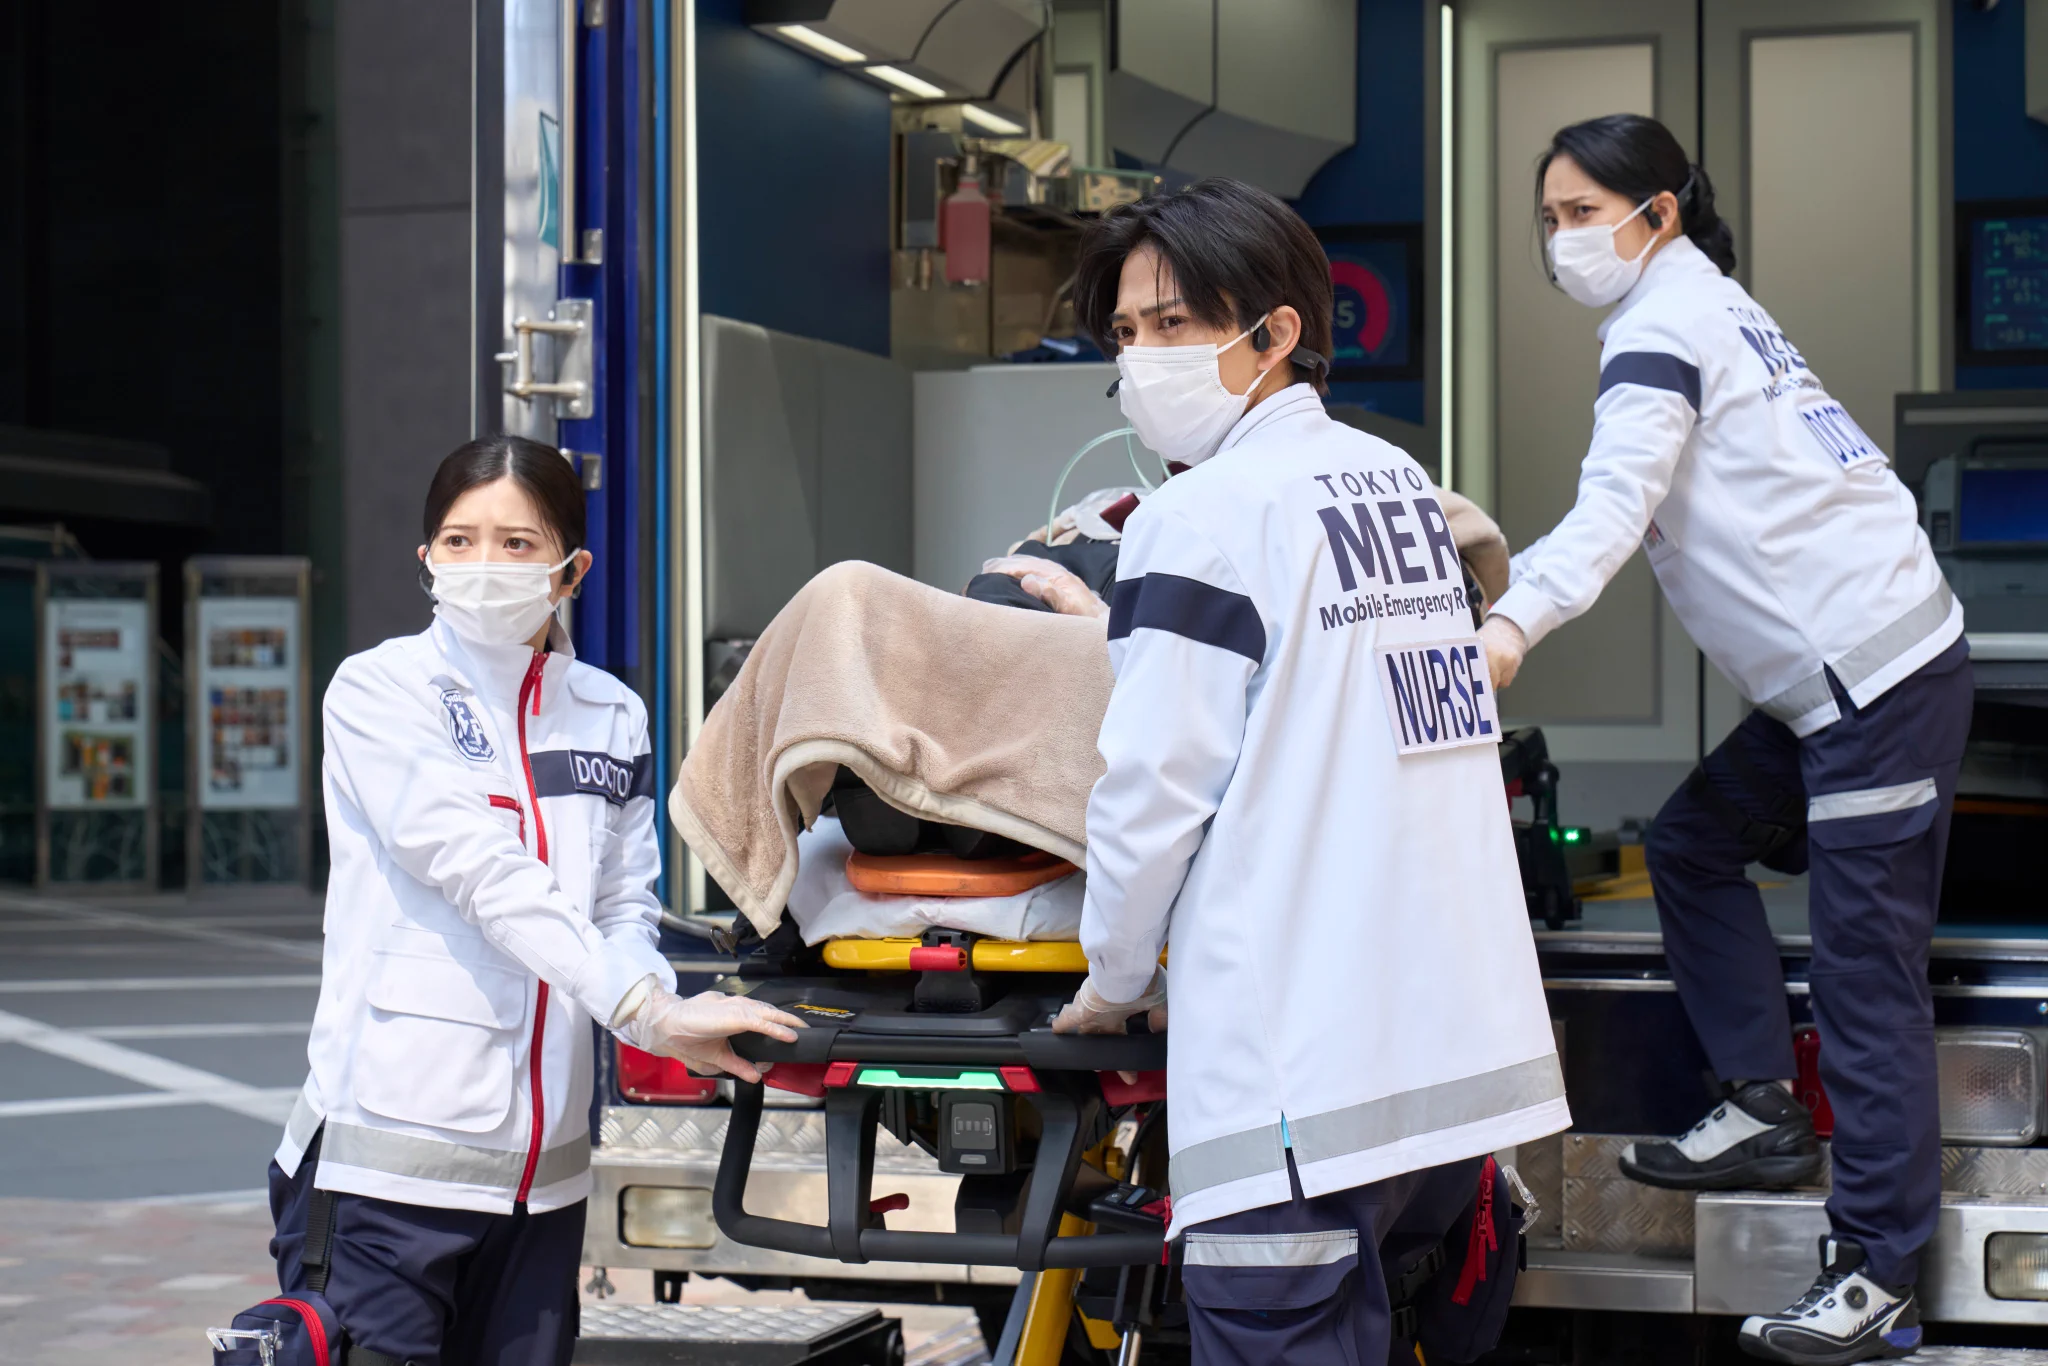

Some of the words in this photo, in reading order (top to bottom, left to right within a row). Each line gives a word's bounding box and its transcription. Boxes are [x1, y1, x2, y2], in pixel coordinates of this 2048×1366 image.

[1314, 466, 1424, 498] TOKYO
[1316, 498, 1462, 592] MER
[1319, 594, 1383, 631] Mobile
[1383, 593, 1453, 621] Emergency
[1385, 645, 1493, 746] NURSE
